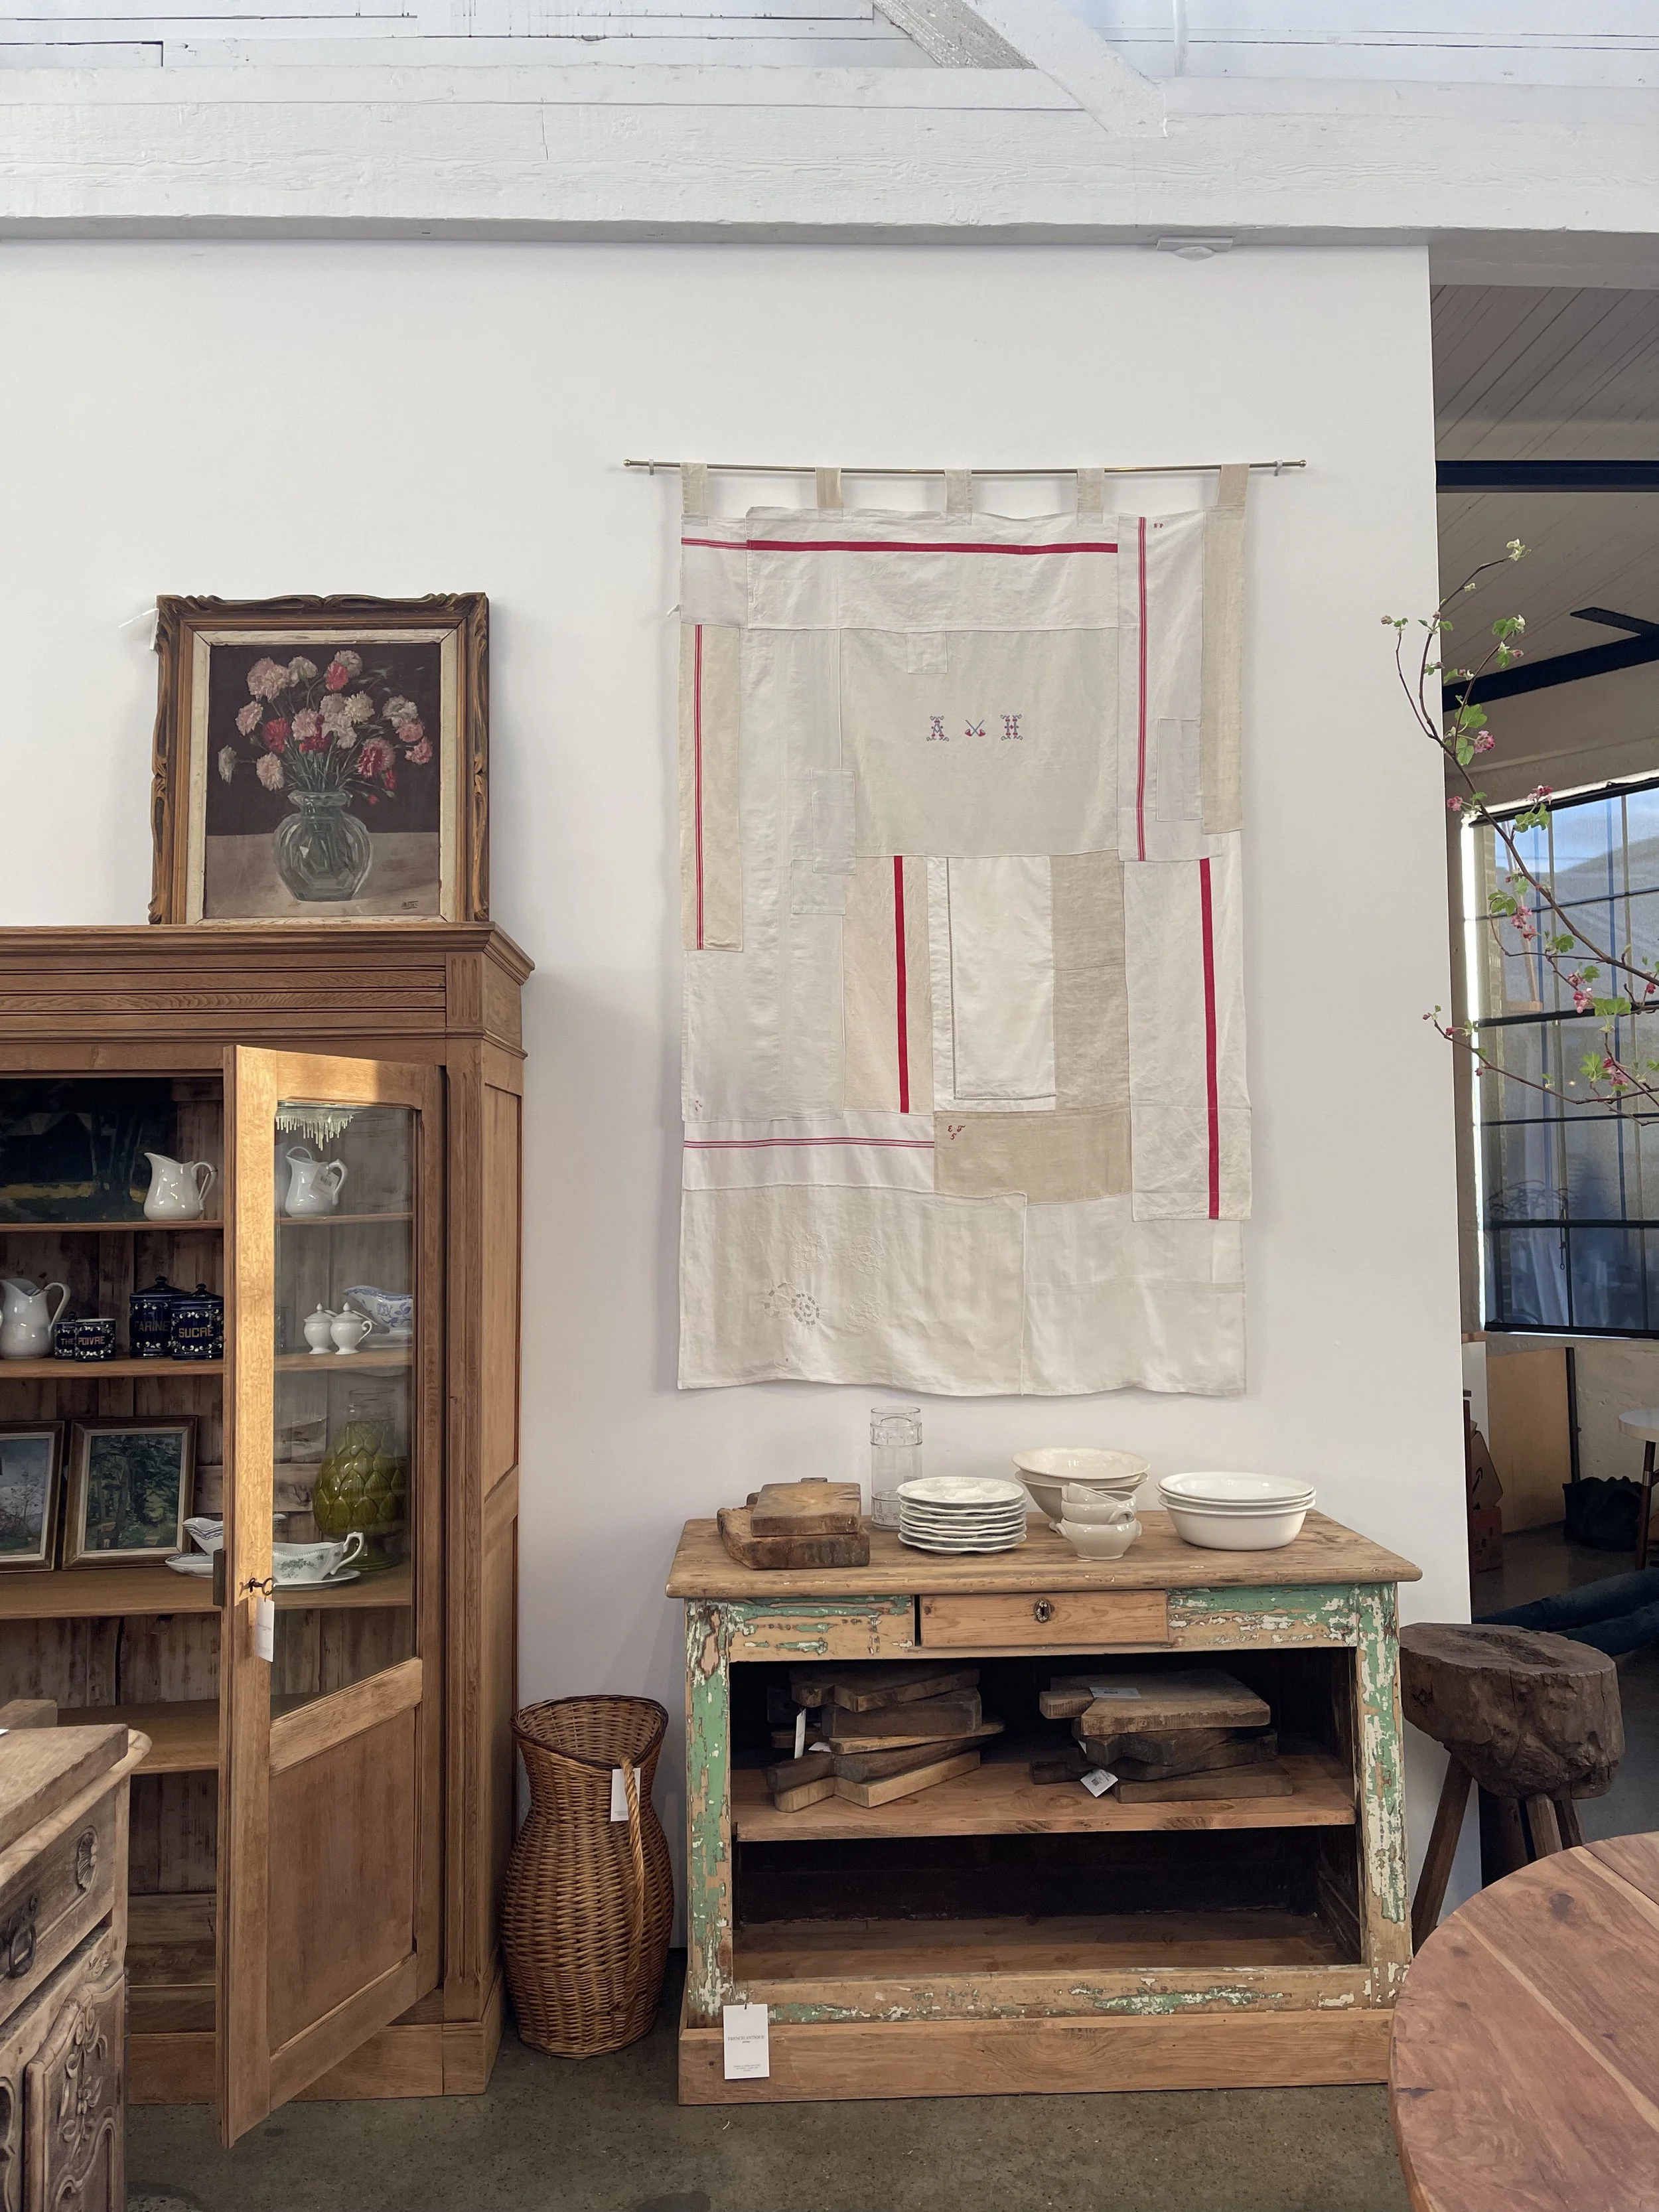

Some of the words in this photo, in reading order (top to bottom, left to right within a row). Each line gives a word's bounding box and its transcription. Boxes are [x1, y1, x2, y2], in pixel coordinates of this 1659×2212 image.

[926, 715, 950, 742] A
[999, 713, 1023, 741] H
[134, 1320, 170, 1333] FARINE
[179, 1327, 214, 1338] SUCRE
[78, 1336, 106, 1345] POIVRE
